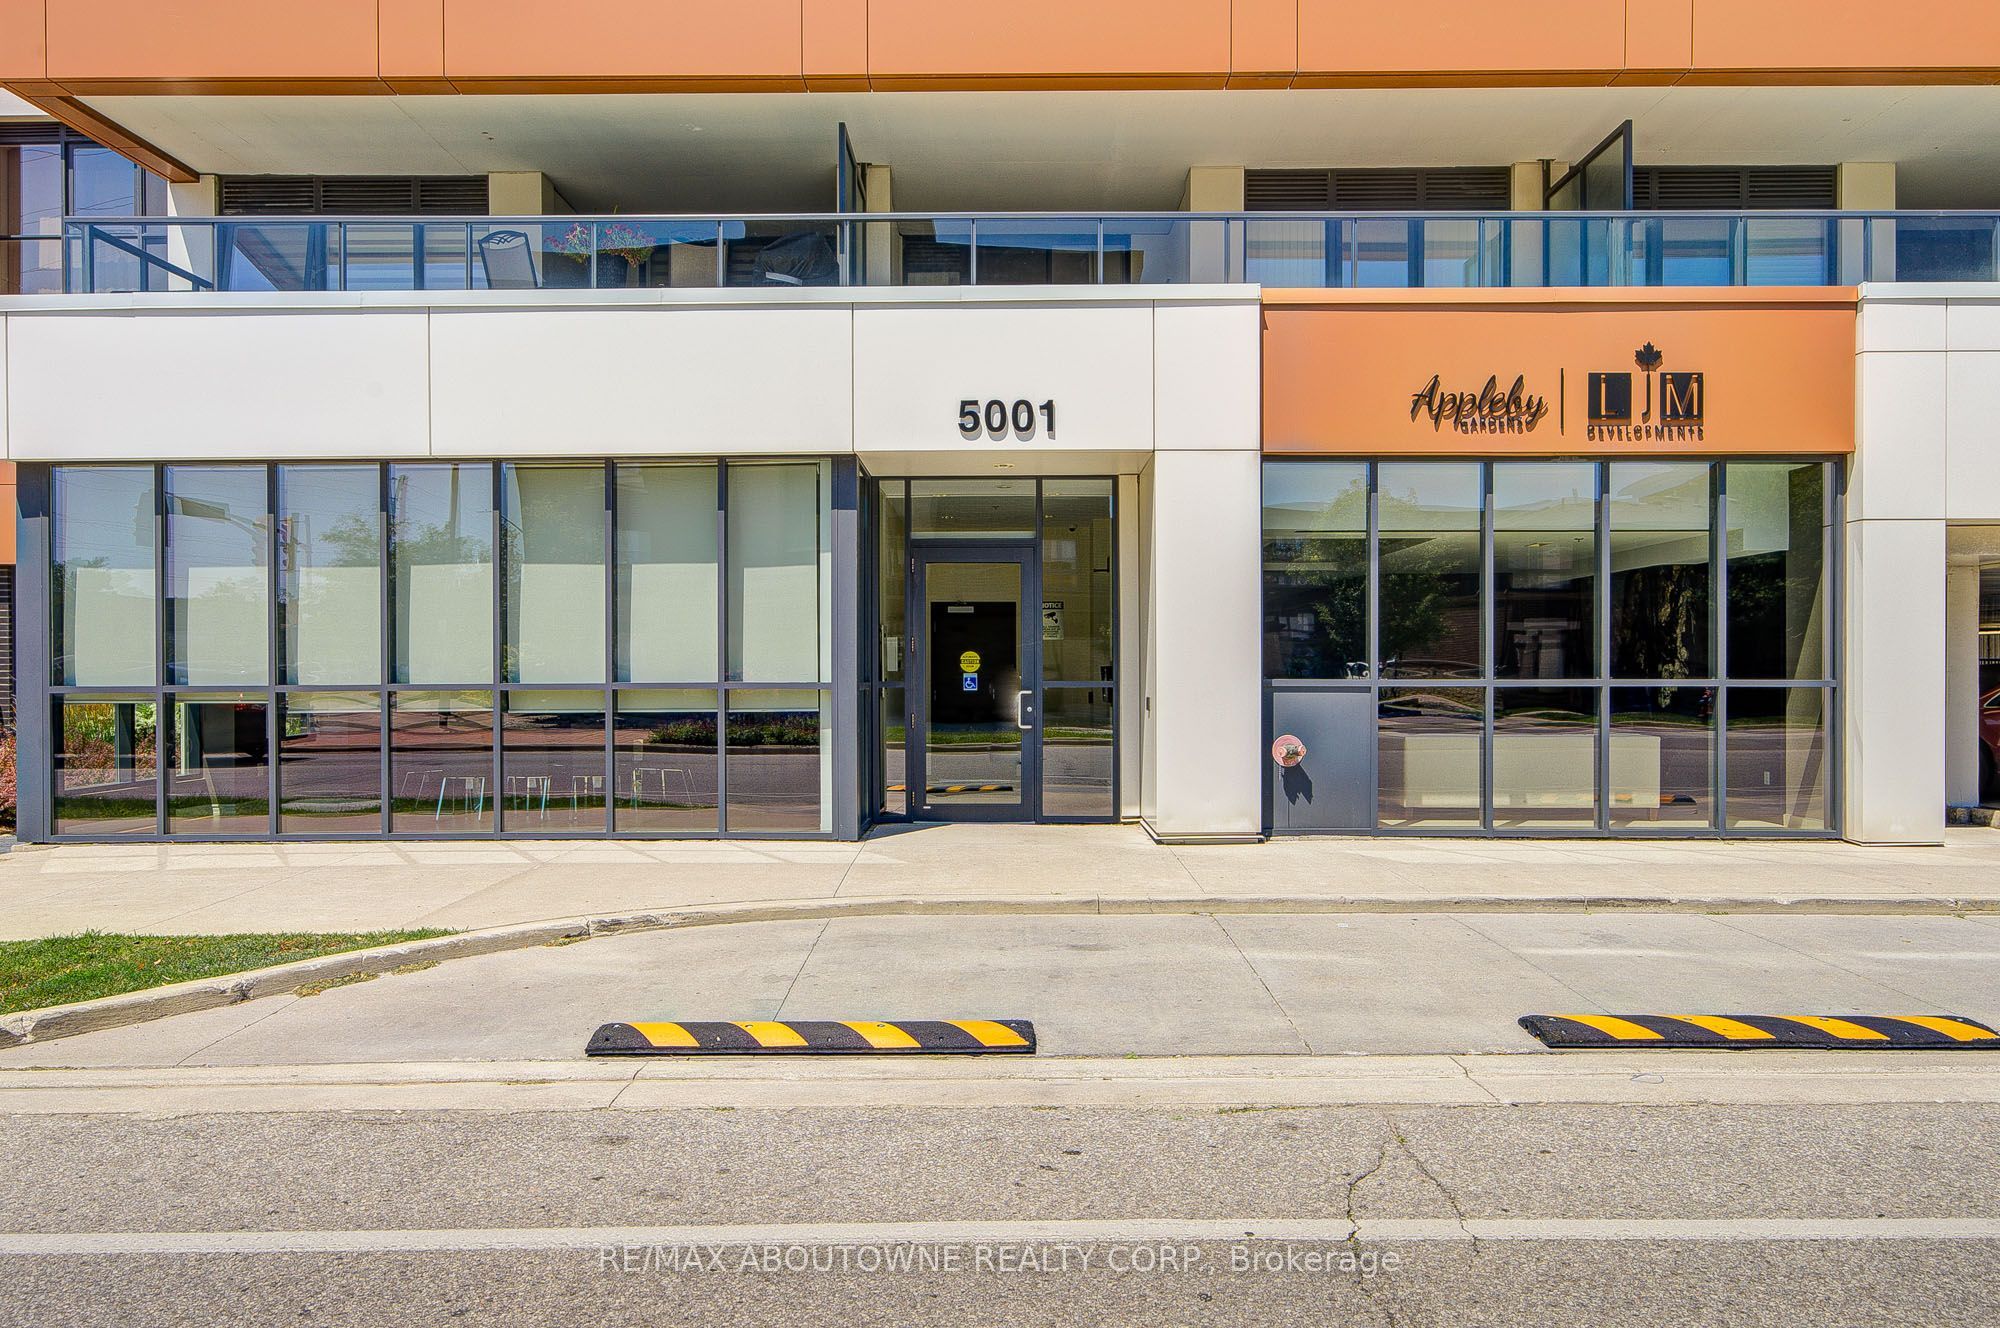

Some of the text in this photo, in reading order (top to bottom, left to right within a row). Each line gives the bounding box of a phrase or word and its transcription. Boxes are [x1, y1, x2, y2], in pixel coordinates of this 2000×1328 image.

[1410, 374, 1547, 430] Appleby
[957, 399, 1055, 434] 5001
[1460, 416, 1524, 433] GARDENS
[1587, 425, 1704, 440] DEVELOPMENTS
